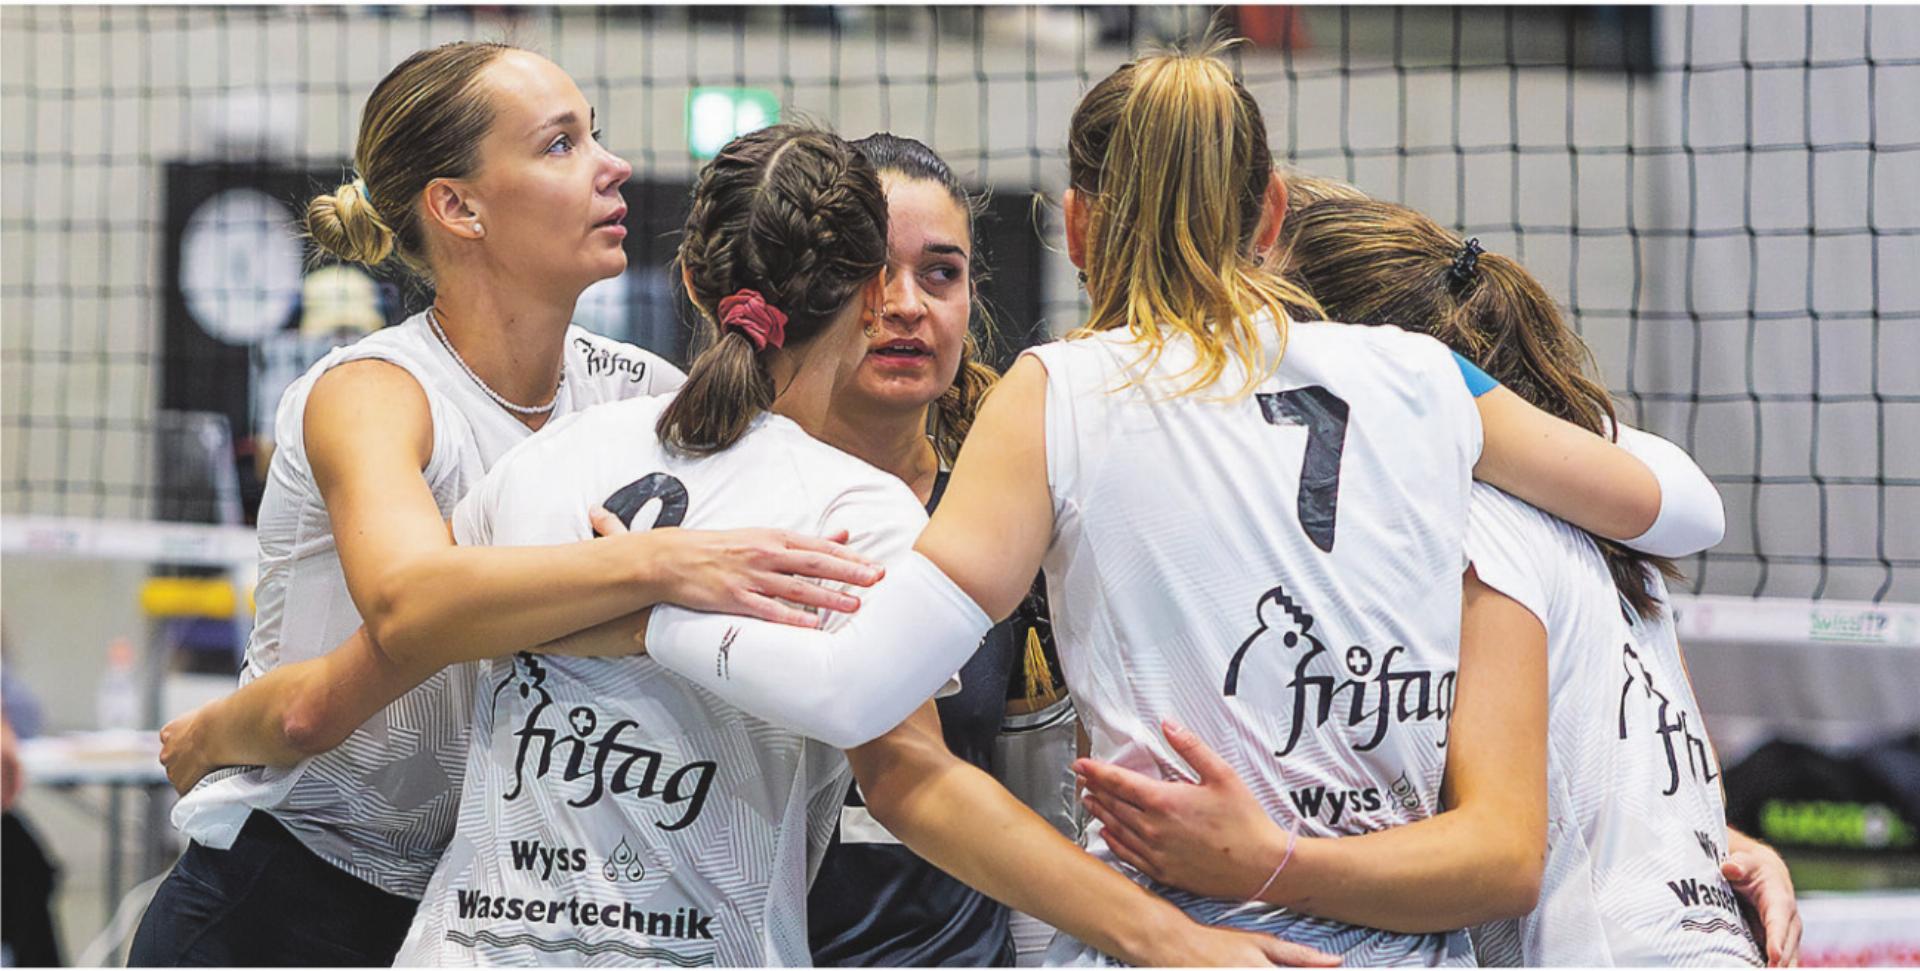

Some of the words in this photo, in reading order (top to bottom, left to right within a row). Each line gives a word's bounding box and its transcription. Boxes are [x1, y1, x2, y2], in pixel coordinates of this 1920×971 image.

[1257, 384, 1350, 553] 7
[502, 699, 717, 832] frifag
[1289, 785, 1382, 826] Wyss
[510, 839, 588, 881] Wyss
[457, 888, 716, 940] Wassertechnik
